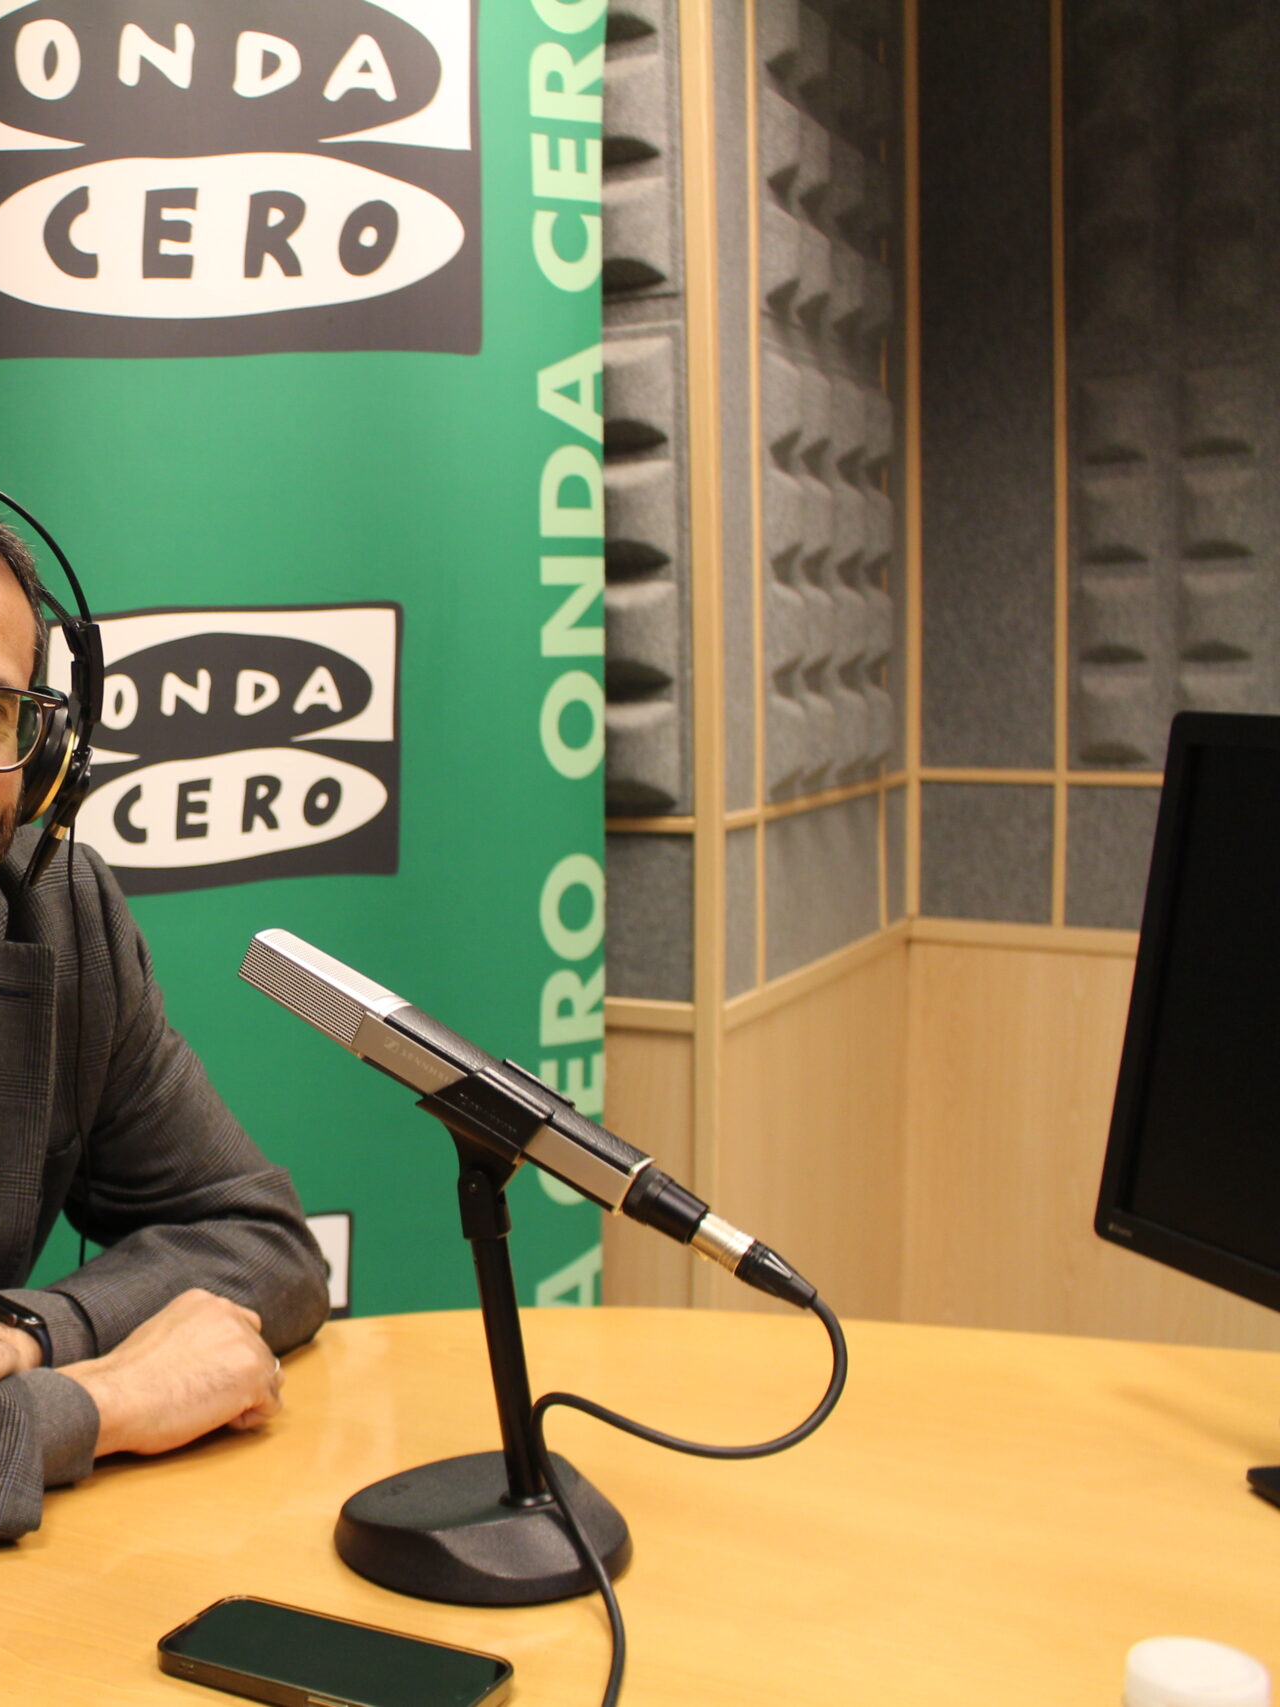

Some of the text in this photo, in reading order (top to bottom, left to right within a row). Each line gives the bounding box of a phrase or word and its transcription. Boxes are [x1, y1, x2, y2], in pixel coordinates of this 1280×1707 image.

[15, 18, 397, 101] ONDA
[43, 185, 400, 279] CERO
[537, 342, 606, 779] ONDA
[100, 666, 342, 730] ONDA
[113, 774, 342, 844] CERO
[537, 853, 605, 1206] ERO
